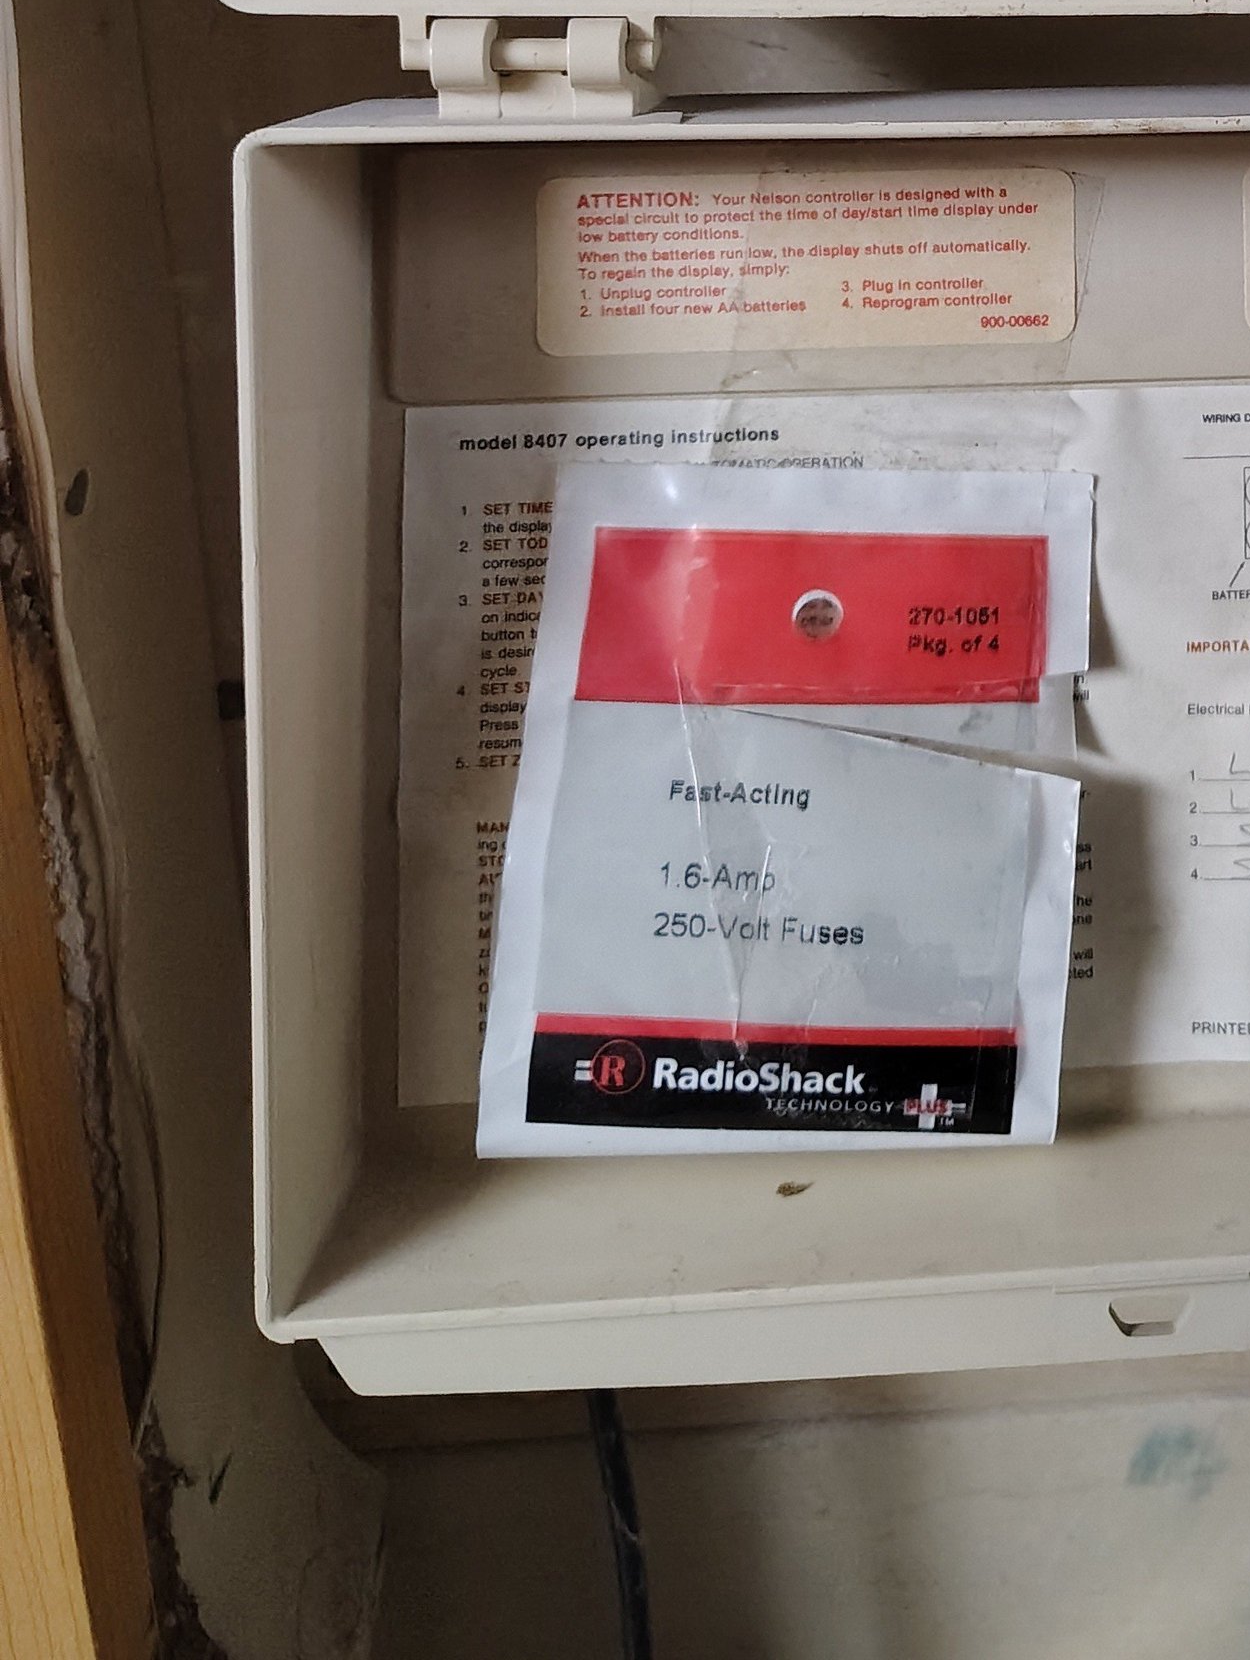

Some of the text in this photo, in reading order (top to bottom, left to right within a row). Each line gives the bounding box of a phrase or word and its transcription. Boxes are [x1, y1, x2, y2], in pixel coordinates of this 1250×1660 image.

[576, 187, 1007, 210] ATTENTION: Your Nelson controller is designed with a
[981, 315, 1048, 328] 900-00662
[1202, 413, 1241, 423] WIRING
[460, 428, 779, 450] model 8407 operating instructions
[908, 635, 999, 657] Pkg. of 4
[670, 780, 809, 809] Fast-Acting
[661, 862, 775, 895] 1.6-Amp
[654, 913, 863, 945] 250-Volt Fuses
[653, 1058, 865, 1094] RadioShack
[766, 1098, 893, 1116] TECHNOLOGY
[905, 1098, 950, 1115] PLUS
